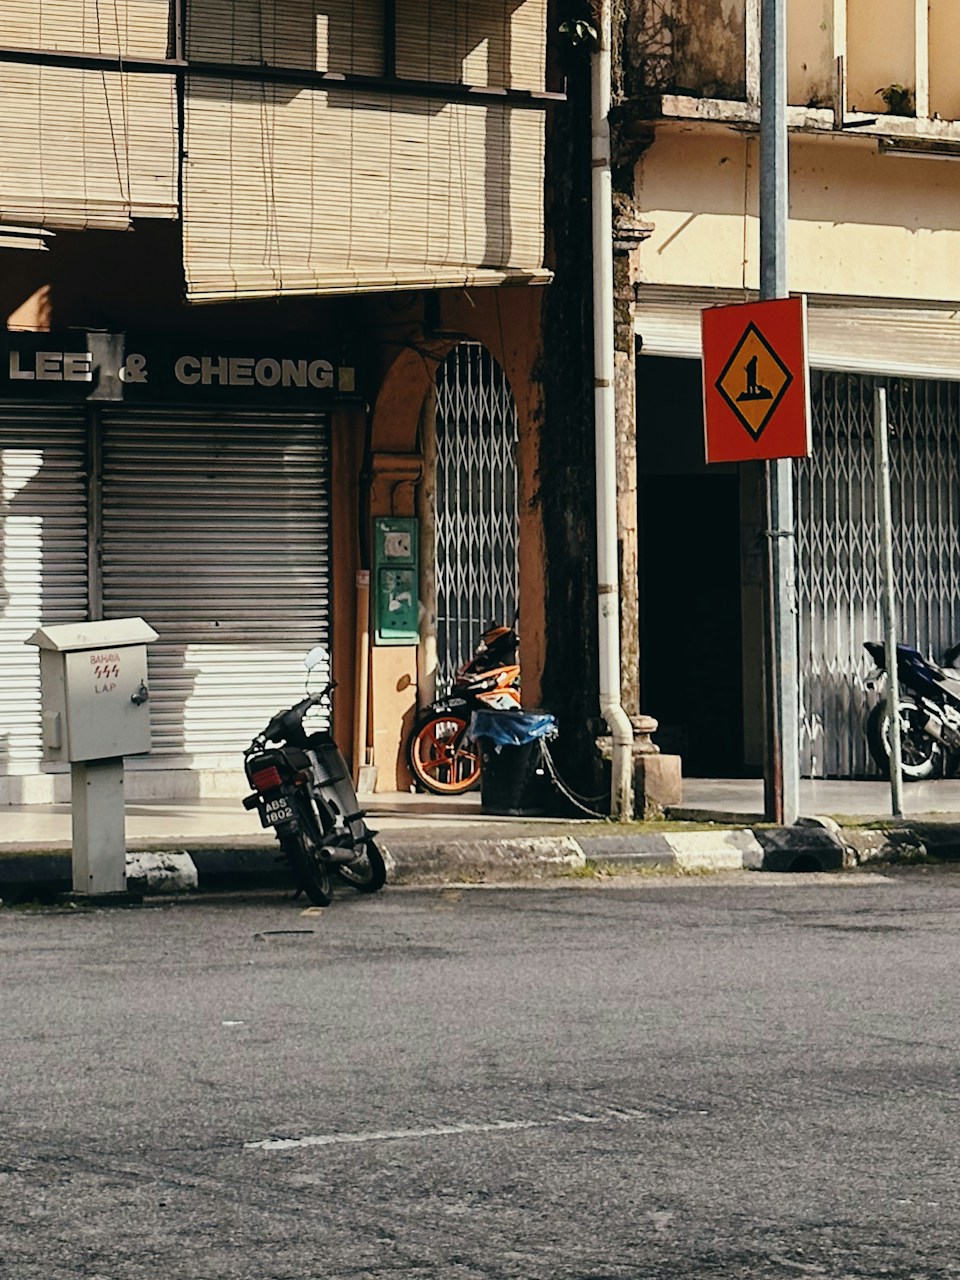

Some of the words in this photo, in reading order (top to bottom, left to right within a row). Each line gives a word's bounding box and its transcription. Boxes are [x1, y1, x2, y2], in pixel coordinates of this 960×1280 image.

[9, 350, 93, 382] LEE
[118, 353, 148, 384] &
[174, 355, 334, 389] CHEONG
